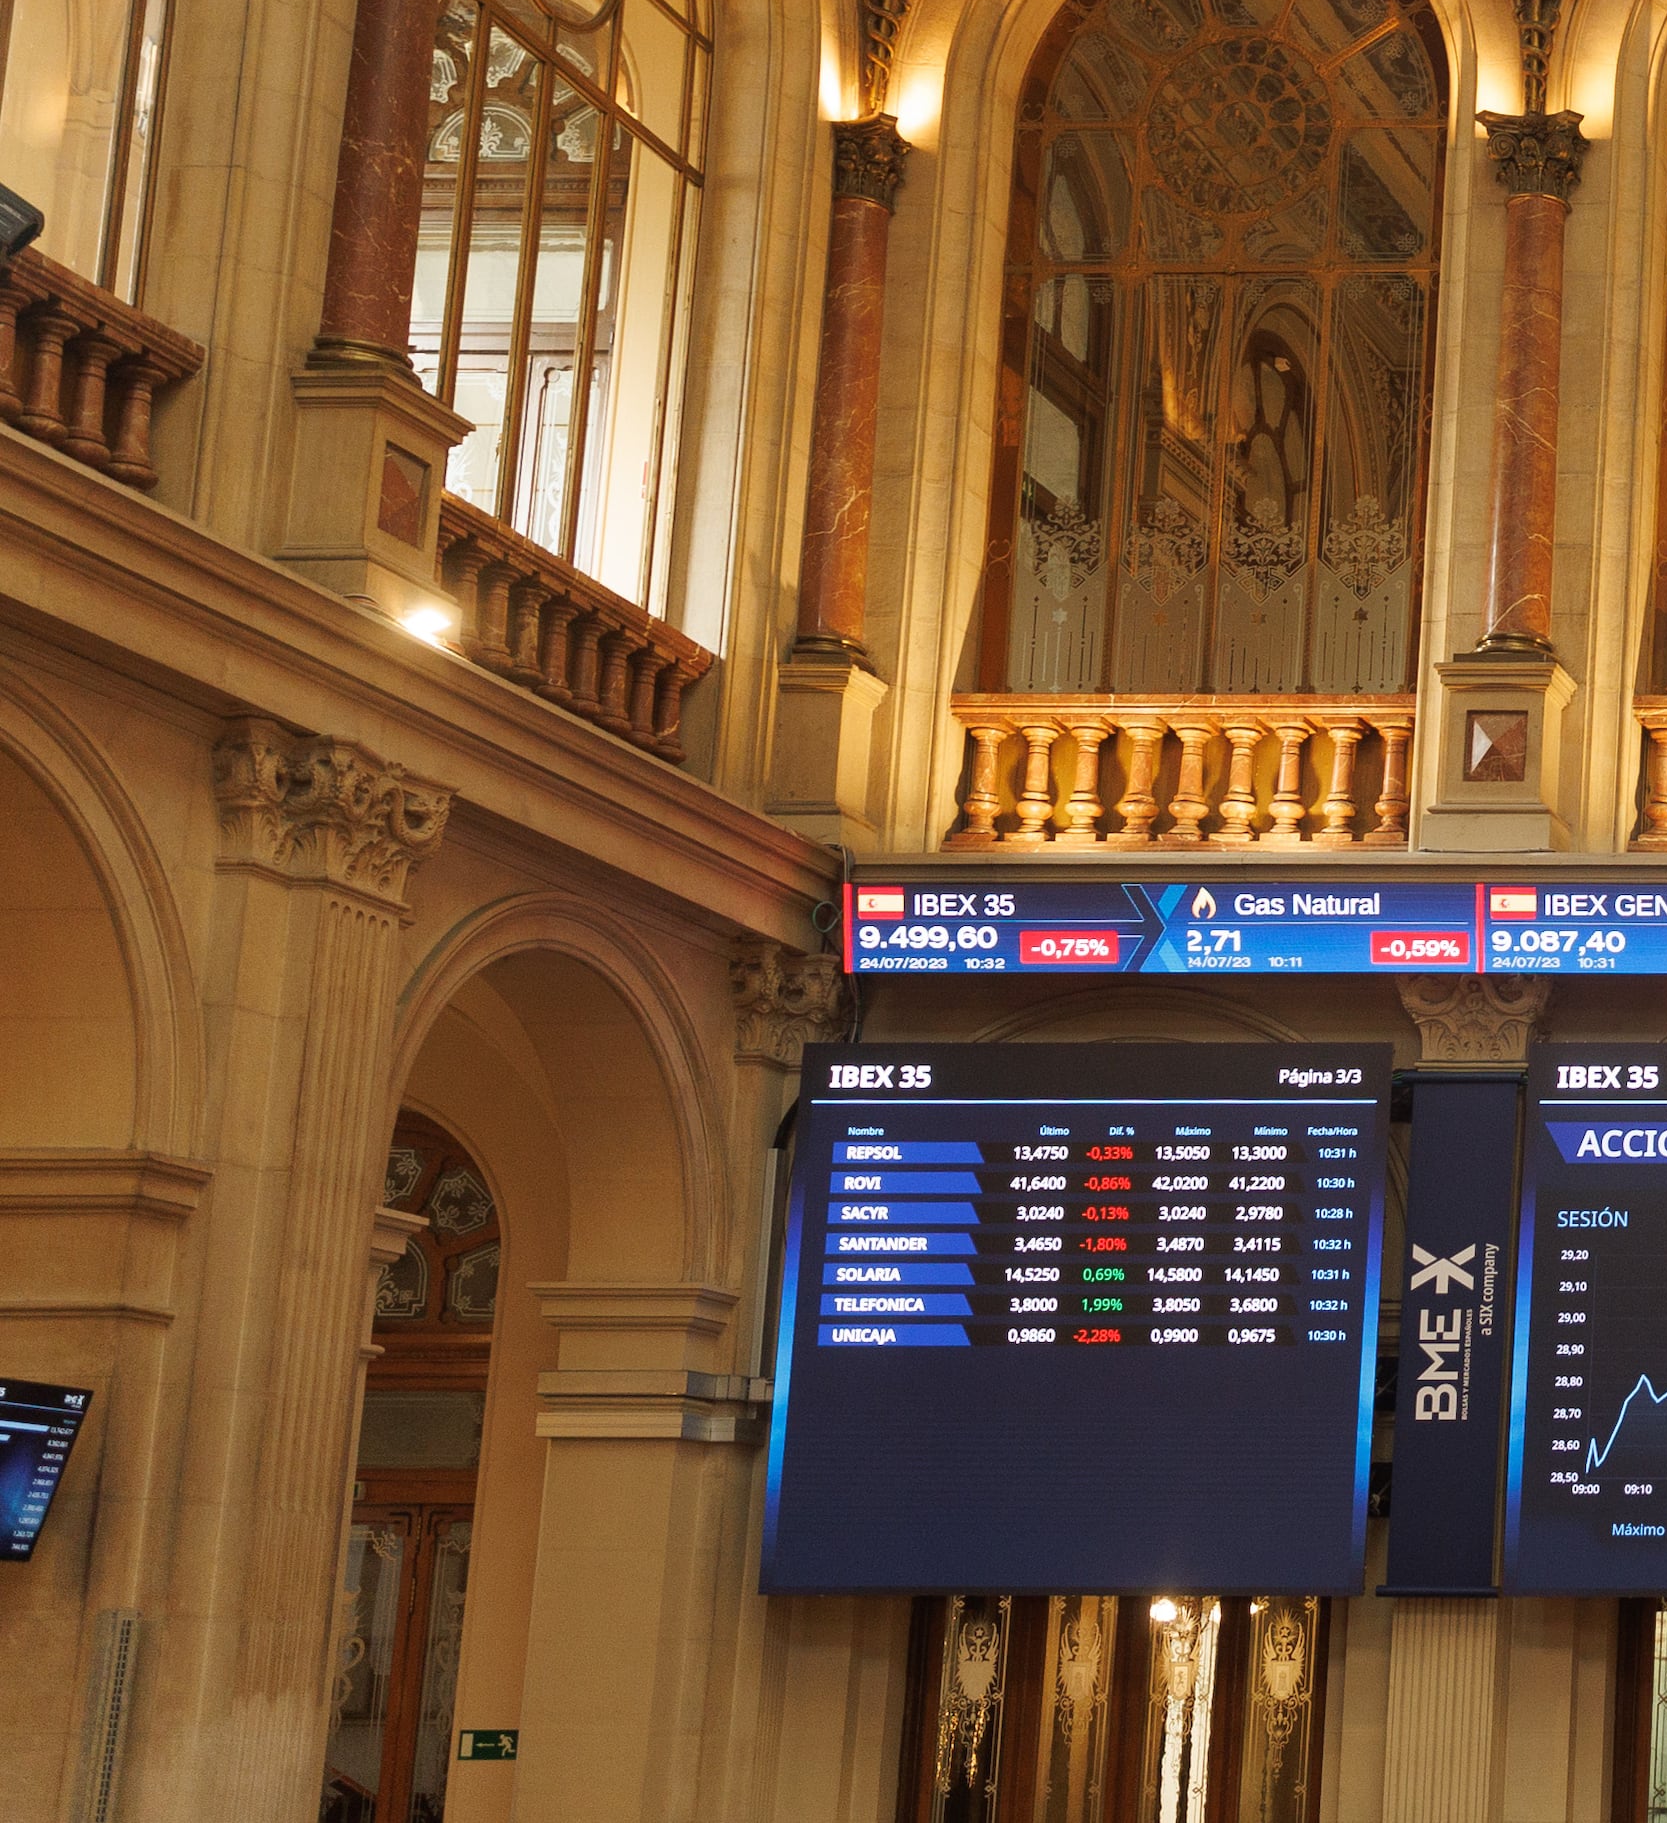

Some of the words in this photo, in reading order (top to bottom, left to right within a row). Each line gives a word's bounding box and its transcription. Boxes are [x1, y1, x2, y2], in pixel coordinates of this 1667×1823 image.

[915, 894, 977, 916] IBEX
[984, 894, 1015, 916] 35
[1234, 893, 1285, 915] Gas
[1293, 892, 1380, 915] Natural
[1545, 894, 1607, 916] IBEX
[859, 926, 998, 951] 9.499,60
[1492, 930, 1625, 956] 9.087,40
[1031, 939, 1109, 959] -0,75%
[1381, 940, 1460, 959] -0,59%
[860, 957, 948, 969] 24/07/2023
[964, 958, 1005, 969] 10:32
[829, 1066, 894, 1088] IBEX
[899, 1065, 931, 1088] 35
[1279, 1068, 1332, 1087] Página
[1336, 1069, 1361, 1084] 3/3
[1557, 1066, 1621, 1088] IBEX
[1627, 1066, 1658, 1089] 35
[848, 1127, 884, 1136] Nombre
[847, 1146, 902, 1160] REPSOL
[1014, 1146, 1068, 1161] 13,4750
[1086, 1147, 1133, 1161] -0,33%
[1156, 1146, 1210, 1161] 13,5050
[1232, 1146, 1287, 1161] 13,3000
[844, 1176, 881, 1190] ROVI
[842, 1206, 888, 1220] SACYR
[1558, 1207, 1628, 1227] SESIÓN
[839, 1237, 927, 1250] SANTANDER
[837, 1268, 901, 1281] SOLARIA
[1482, 1242, 1500, 1302] company
[834, 1298, 924, 1311] TELEFONICA
[1010, 1298, 1057, 1313] 3,8000
[1082, 1299, 1122, 1312] 1,99%
[1479, 1303, 1493, 1325] SIX
[832, 1329, 896, 1345] UNICAJA
[1481, 1325, 1492, 1336] a
[1415, 1308, 1462, 1421] BME
[1612, 1523, 1665, 1536] Máximo
